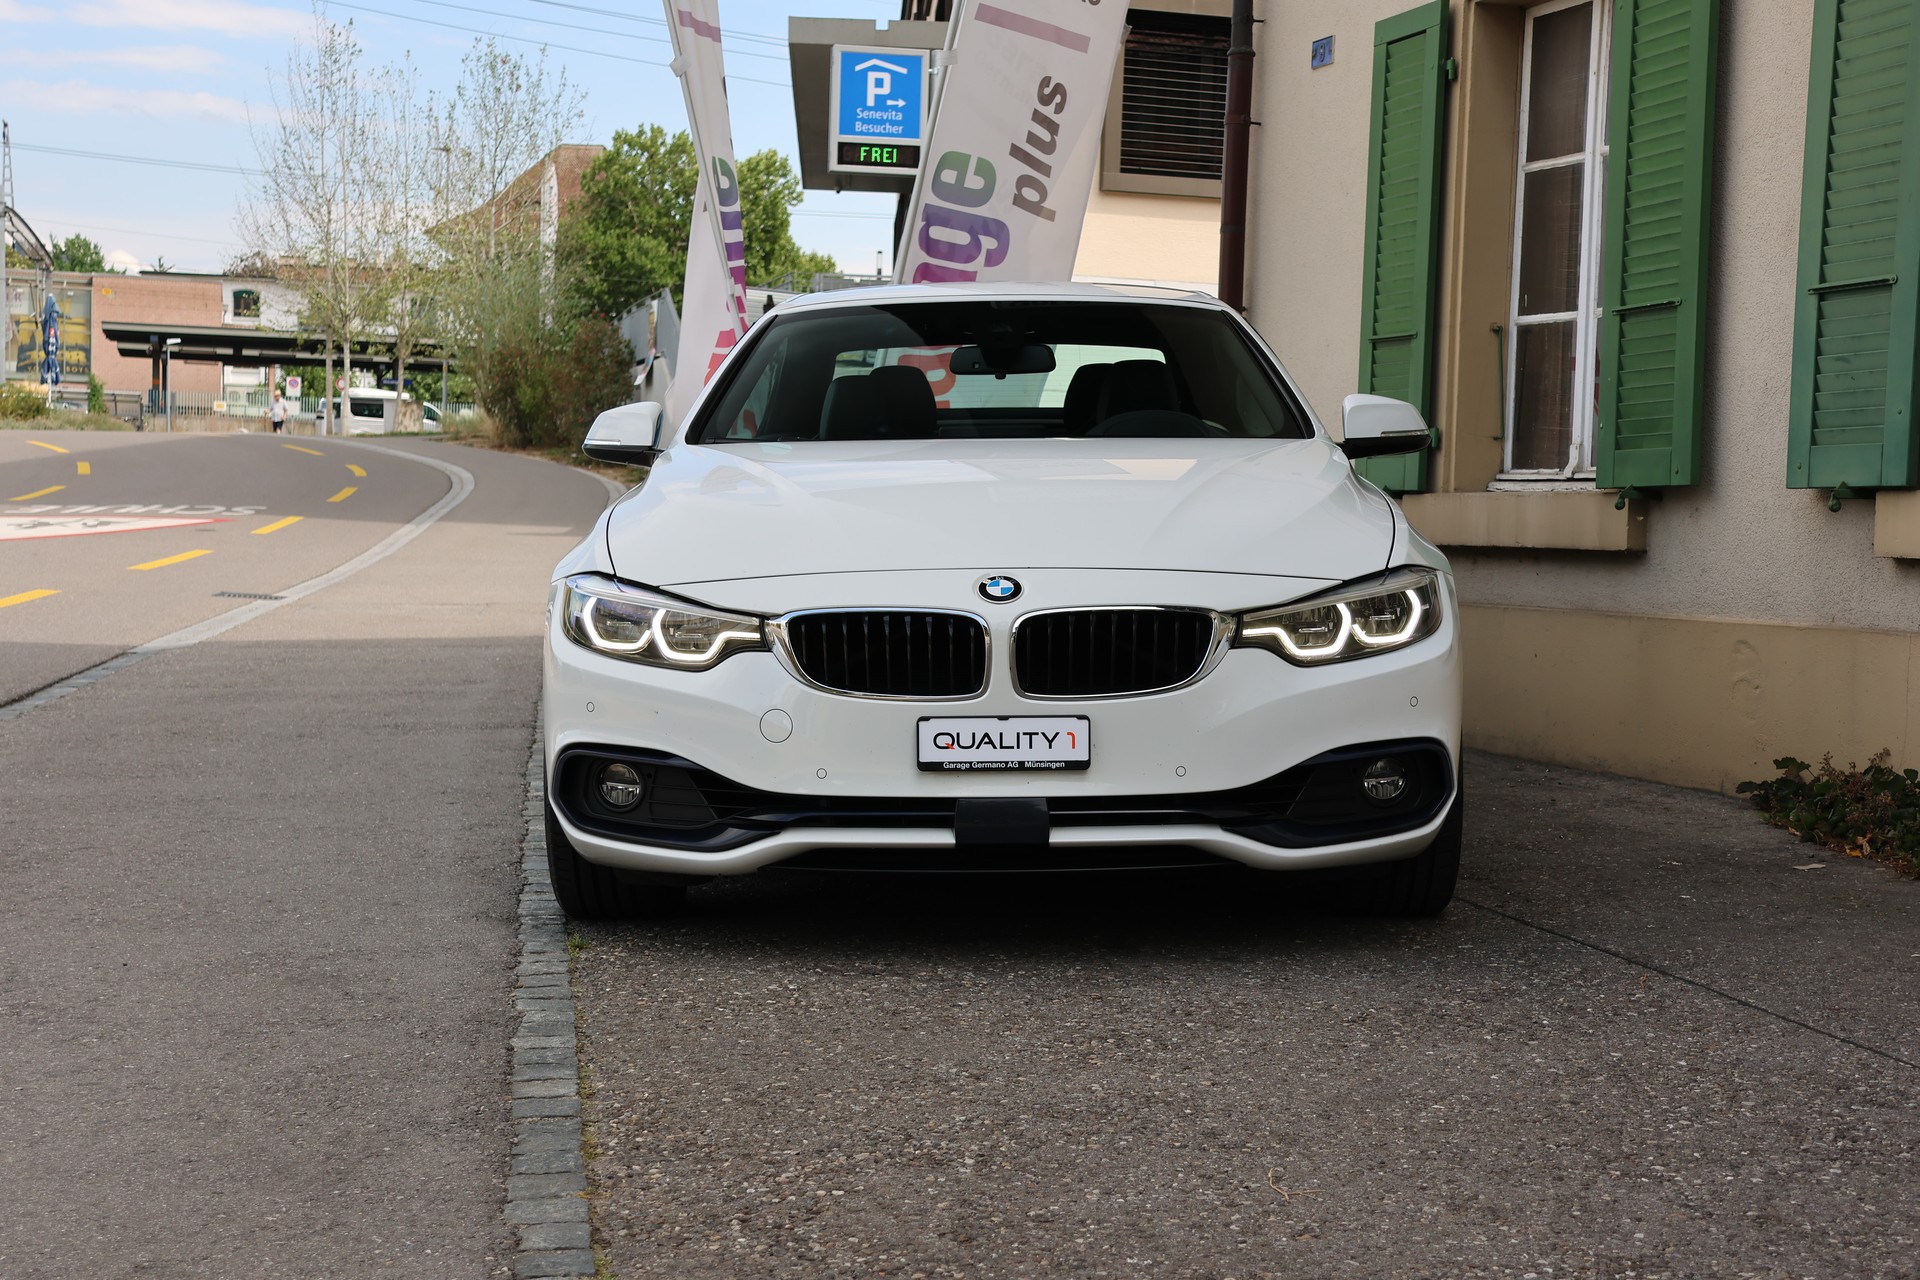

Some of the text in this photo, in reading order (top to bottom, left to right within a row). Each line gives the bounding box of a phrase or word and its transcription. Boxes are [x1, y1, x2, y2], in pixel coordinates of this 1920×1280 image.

[866, 71, 891, 107] P
[856, 107, 902, 120] Senevita
[855, 121, 904, 134] Besucher
[860, 146, 897, 163] FREI
[1009, 75, 1067, 222] plus
[4, 503, 268, 516] SCHULE
[933, 731, 1060, 750] QUALITY
[943, 760, 1065, 770] Garage Germano AG Münsingen
